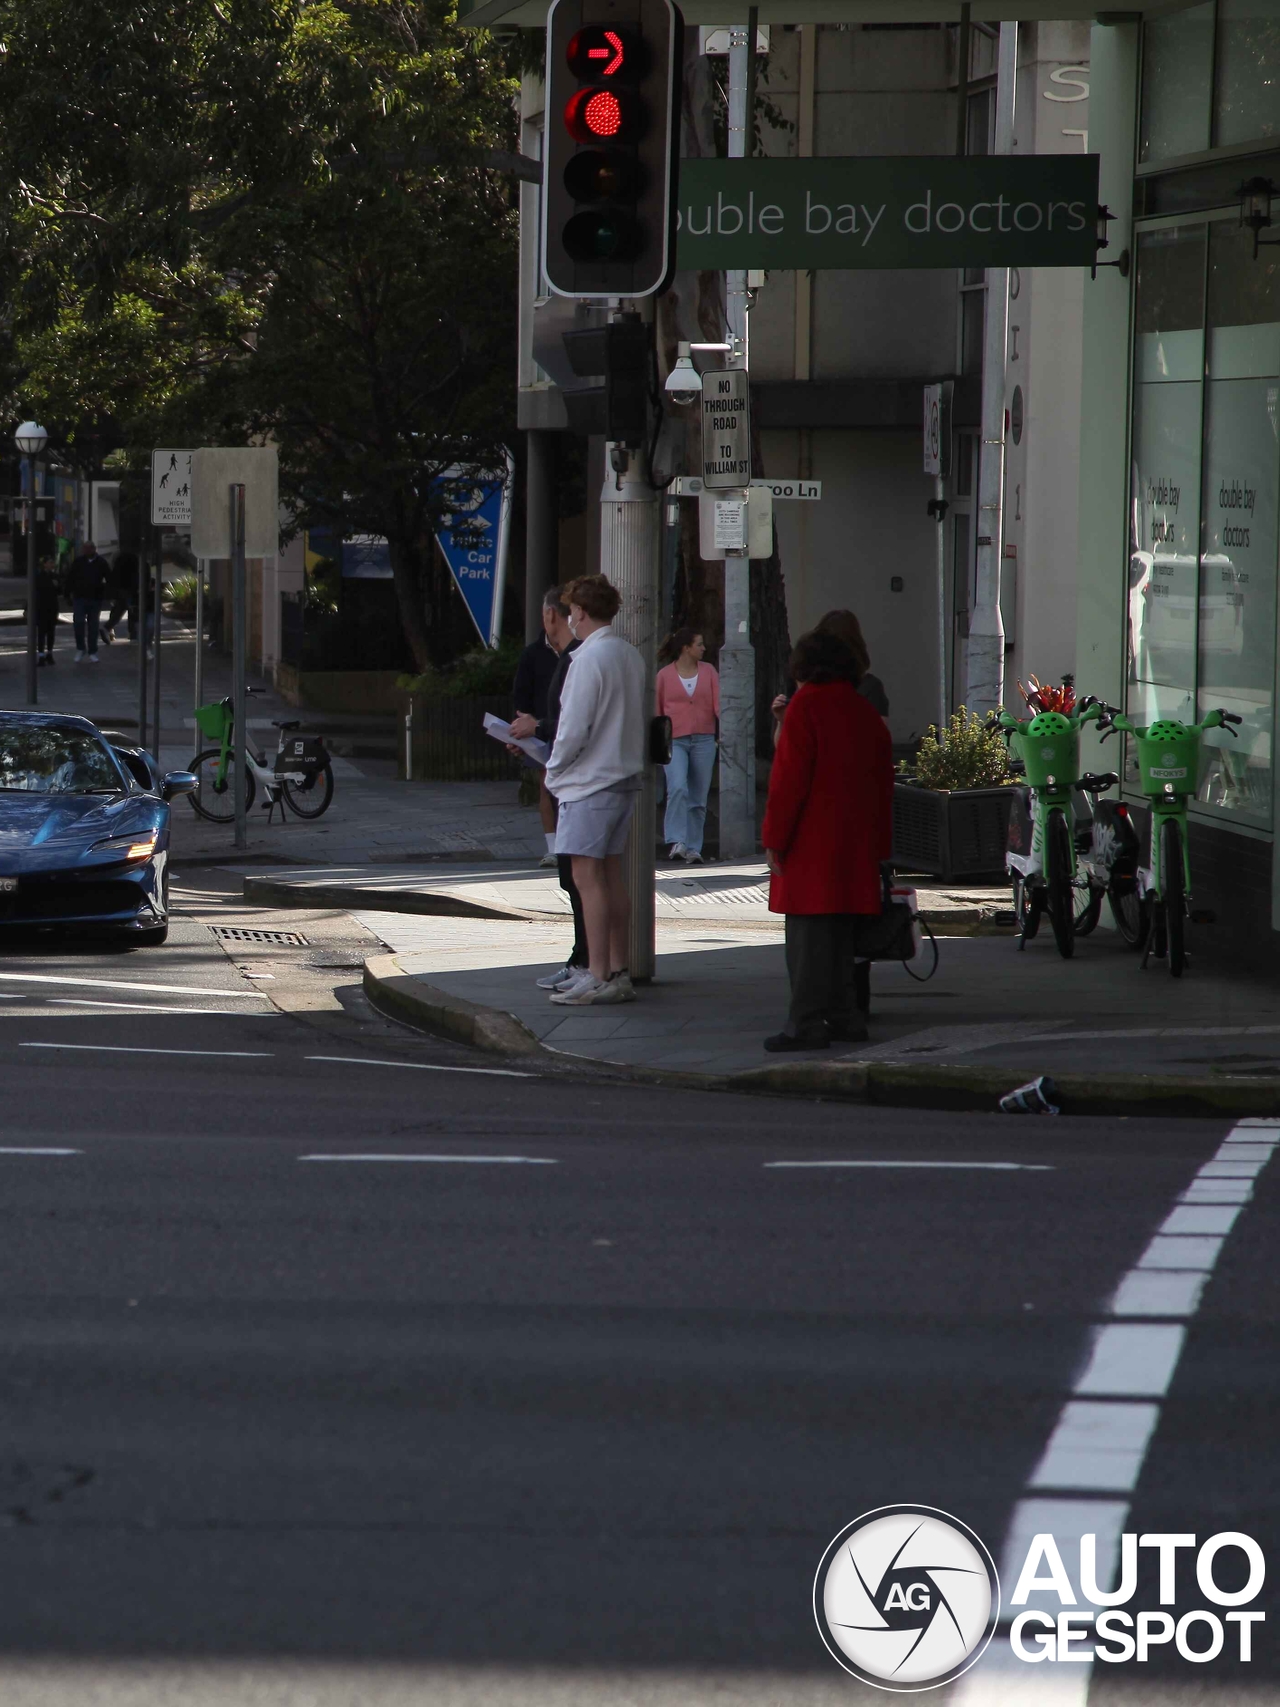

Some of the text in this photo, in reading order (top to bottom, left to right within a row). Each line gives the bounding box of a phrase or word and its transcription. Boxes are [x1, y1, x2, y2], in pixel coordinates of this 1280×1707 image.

[676, 190, 1087, 246] uble bay doctors
[718, 380, 731, 393] NO
[704, 399, 745, 413] THROUGH
[713, 417, 737, 430] ROAD
[720, 445, 732, 458] TO
[705, 460, 748, 475] WILLIAM ST
[798, 483, 818, 497] Ln
[1170, 478, 1181, 515] bay
[1219, 479, 1257, 518] double bay
[1223, 518, 1250, 548] doctors
[468, 551, 493, 563] Car
[459, 566, 490, 579] Park
